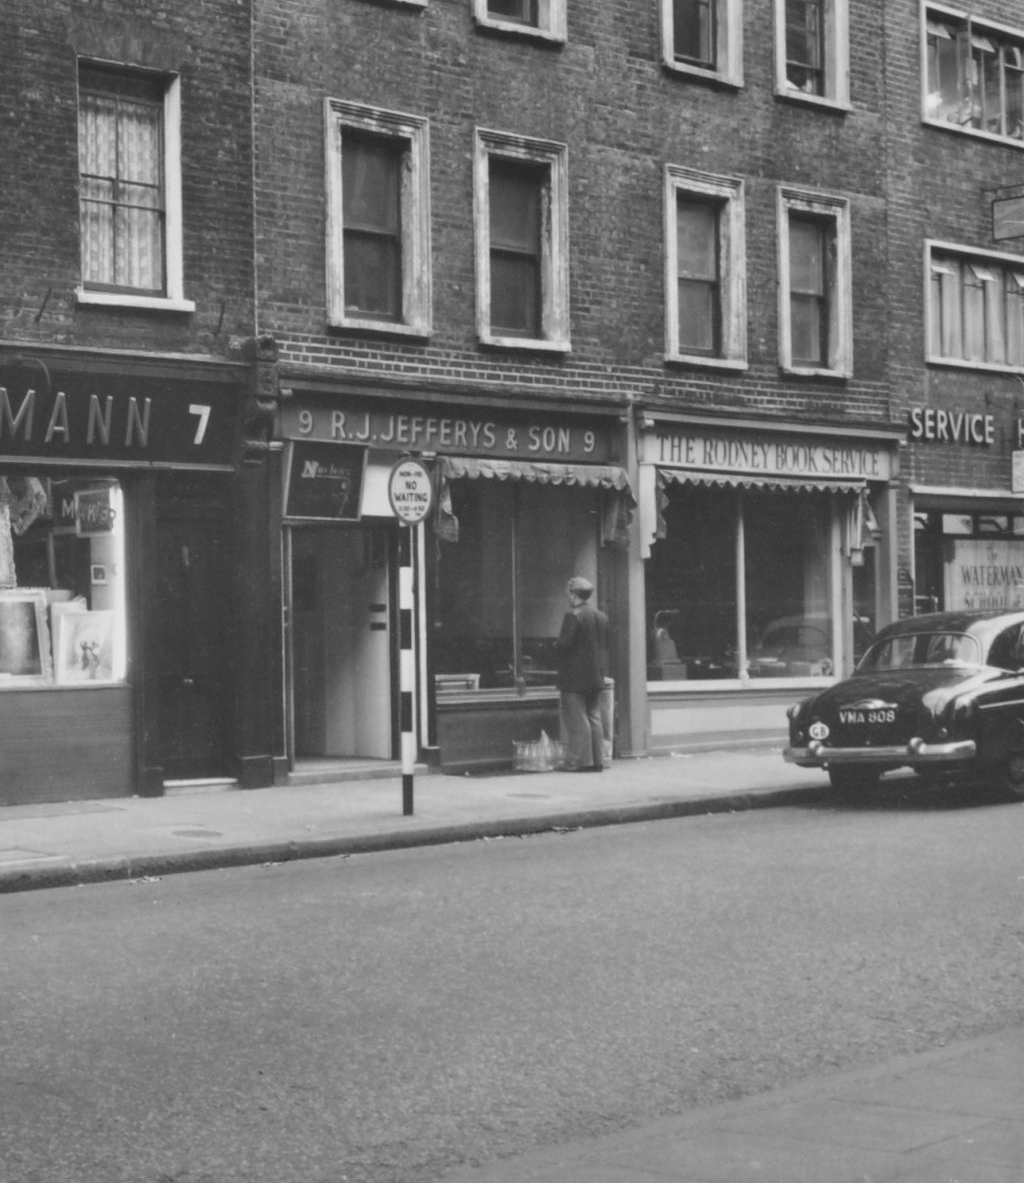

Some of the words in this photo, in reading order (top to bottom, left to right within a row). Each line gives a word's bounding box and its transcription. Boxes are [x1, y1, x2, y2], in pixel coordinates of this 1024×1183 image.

[188, 403, 212, 445] 7
[298, 410, 314, 435] 9
[506, 428, 519, 451] &
[528, 426, 571, 453] SON
[583, 430, 596, 453] 9
[912, 407, 994, 444] SERVICE
[657, 433, 696, 465] THE
[703, 436, 771, 469] RODNEY
[776, 443, 817, 473] BOOK
[822, 447, 880, 477] SERVICE
[394, 493, 427, 502] WAITING
[405, 480, 417, 490] NO
[839, 710, 865, 724] VMA
[868, 709, 896, 723] 808
[811, 725, 826, 737] GB
